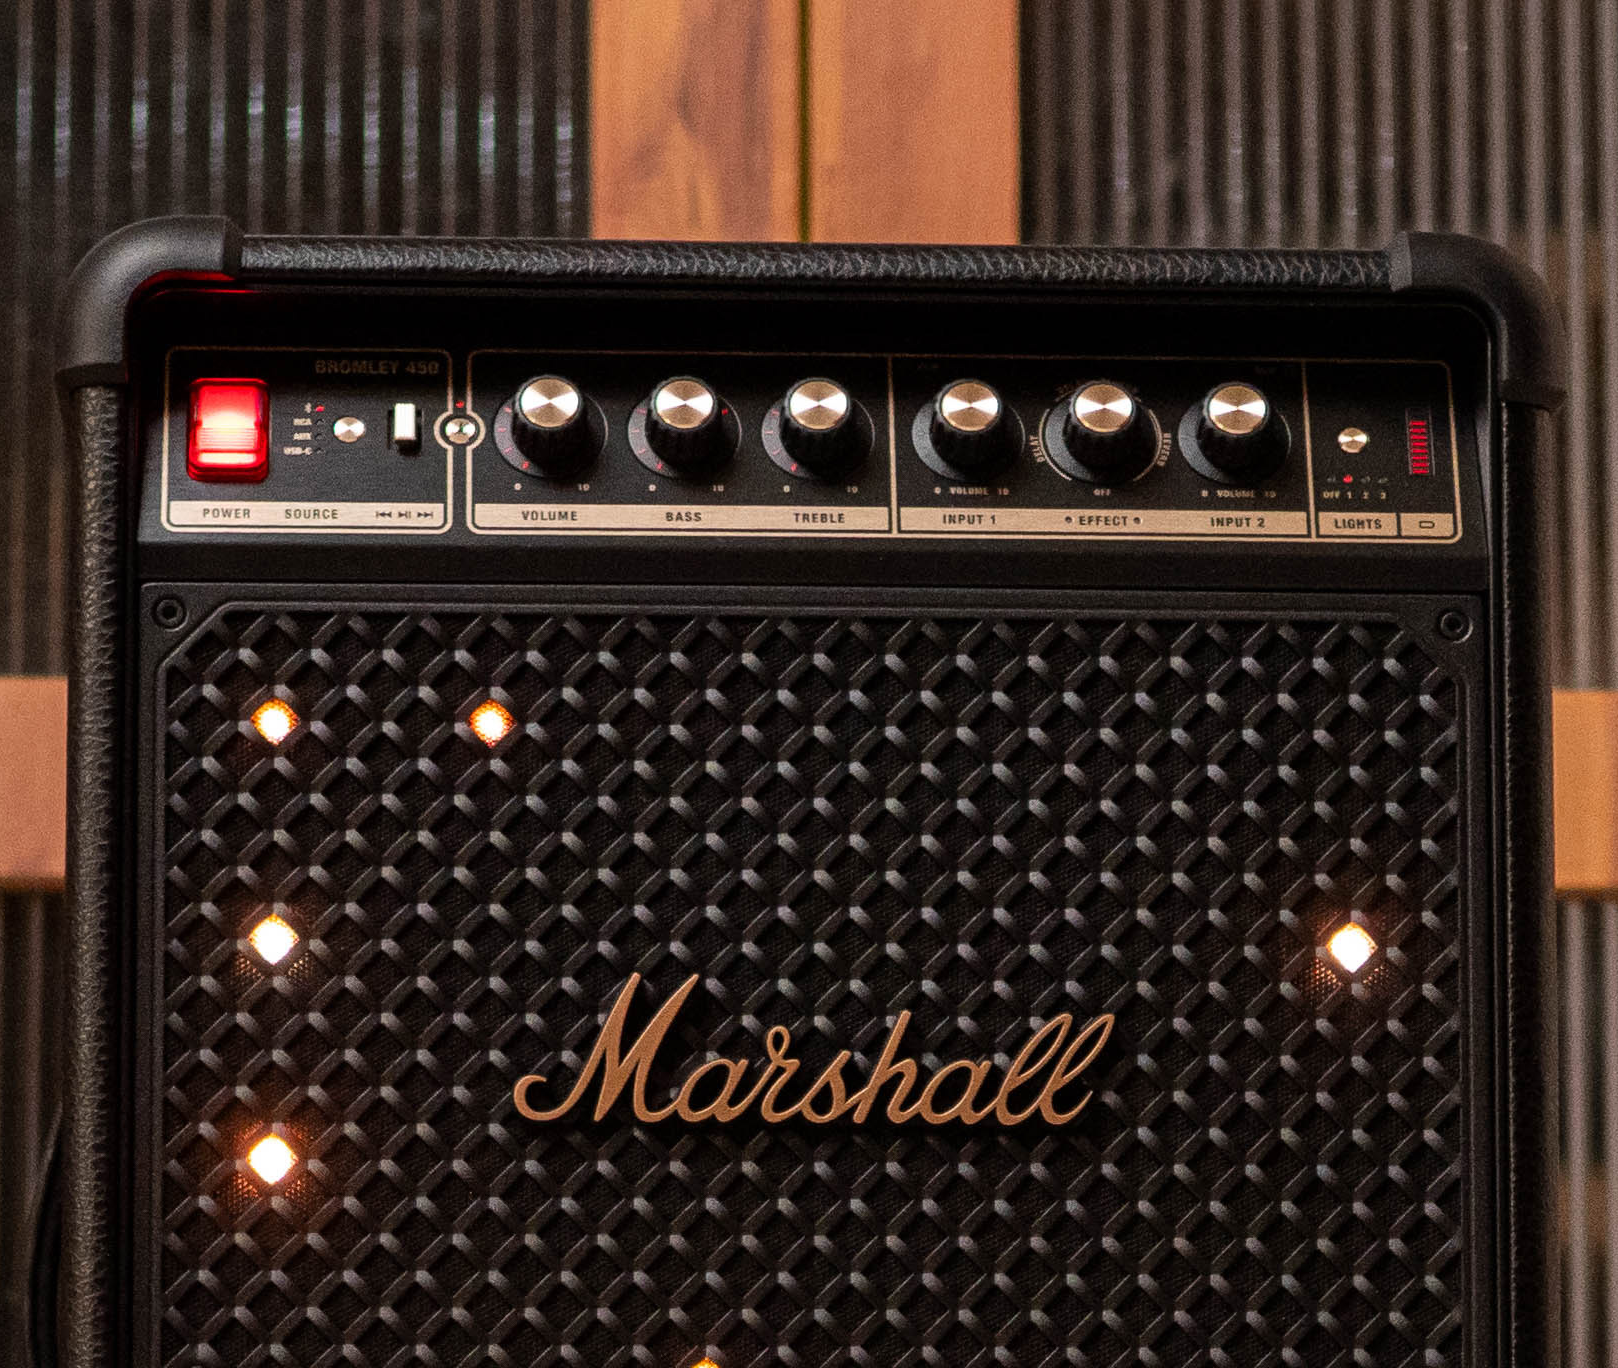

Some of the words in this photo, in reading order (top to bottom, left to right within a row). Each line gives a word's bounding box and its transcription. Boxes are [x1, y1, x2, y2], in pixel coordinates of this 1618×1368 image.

[315, 360, 398, 375] BROMLEY
[405, 361, 440, 375] 450
[950, 487, 989, 496] VOLUME
[1093, 488, 1112, 497] OFF
[203, 508, 251, 519] POWER
[284, 508, 339, 519] SOURCE
[521, 510, 579, 521] VOLUME
[665, 511, 703, 523] BASS
[794, 512, 846, 524] TREBLE
[942, 514, 984, 525] INPUT
[989, 514, 997, 525] 1
[1078, 515, 1128, 527] EFFECT
[1210, 516, 1250, 528] INPUT
[1256, 516, 1266, 528] 2
[1334, 518, 1383, 530] LIGHTS
[513, 972, 1116, 1126] Marshall
